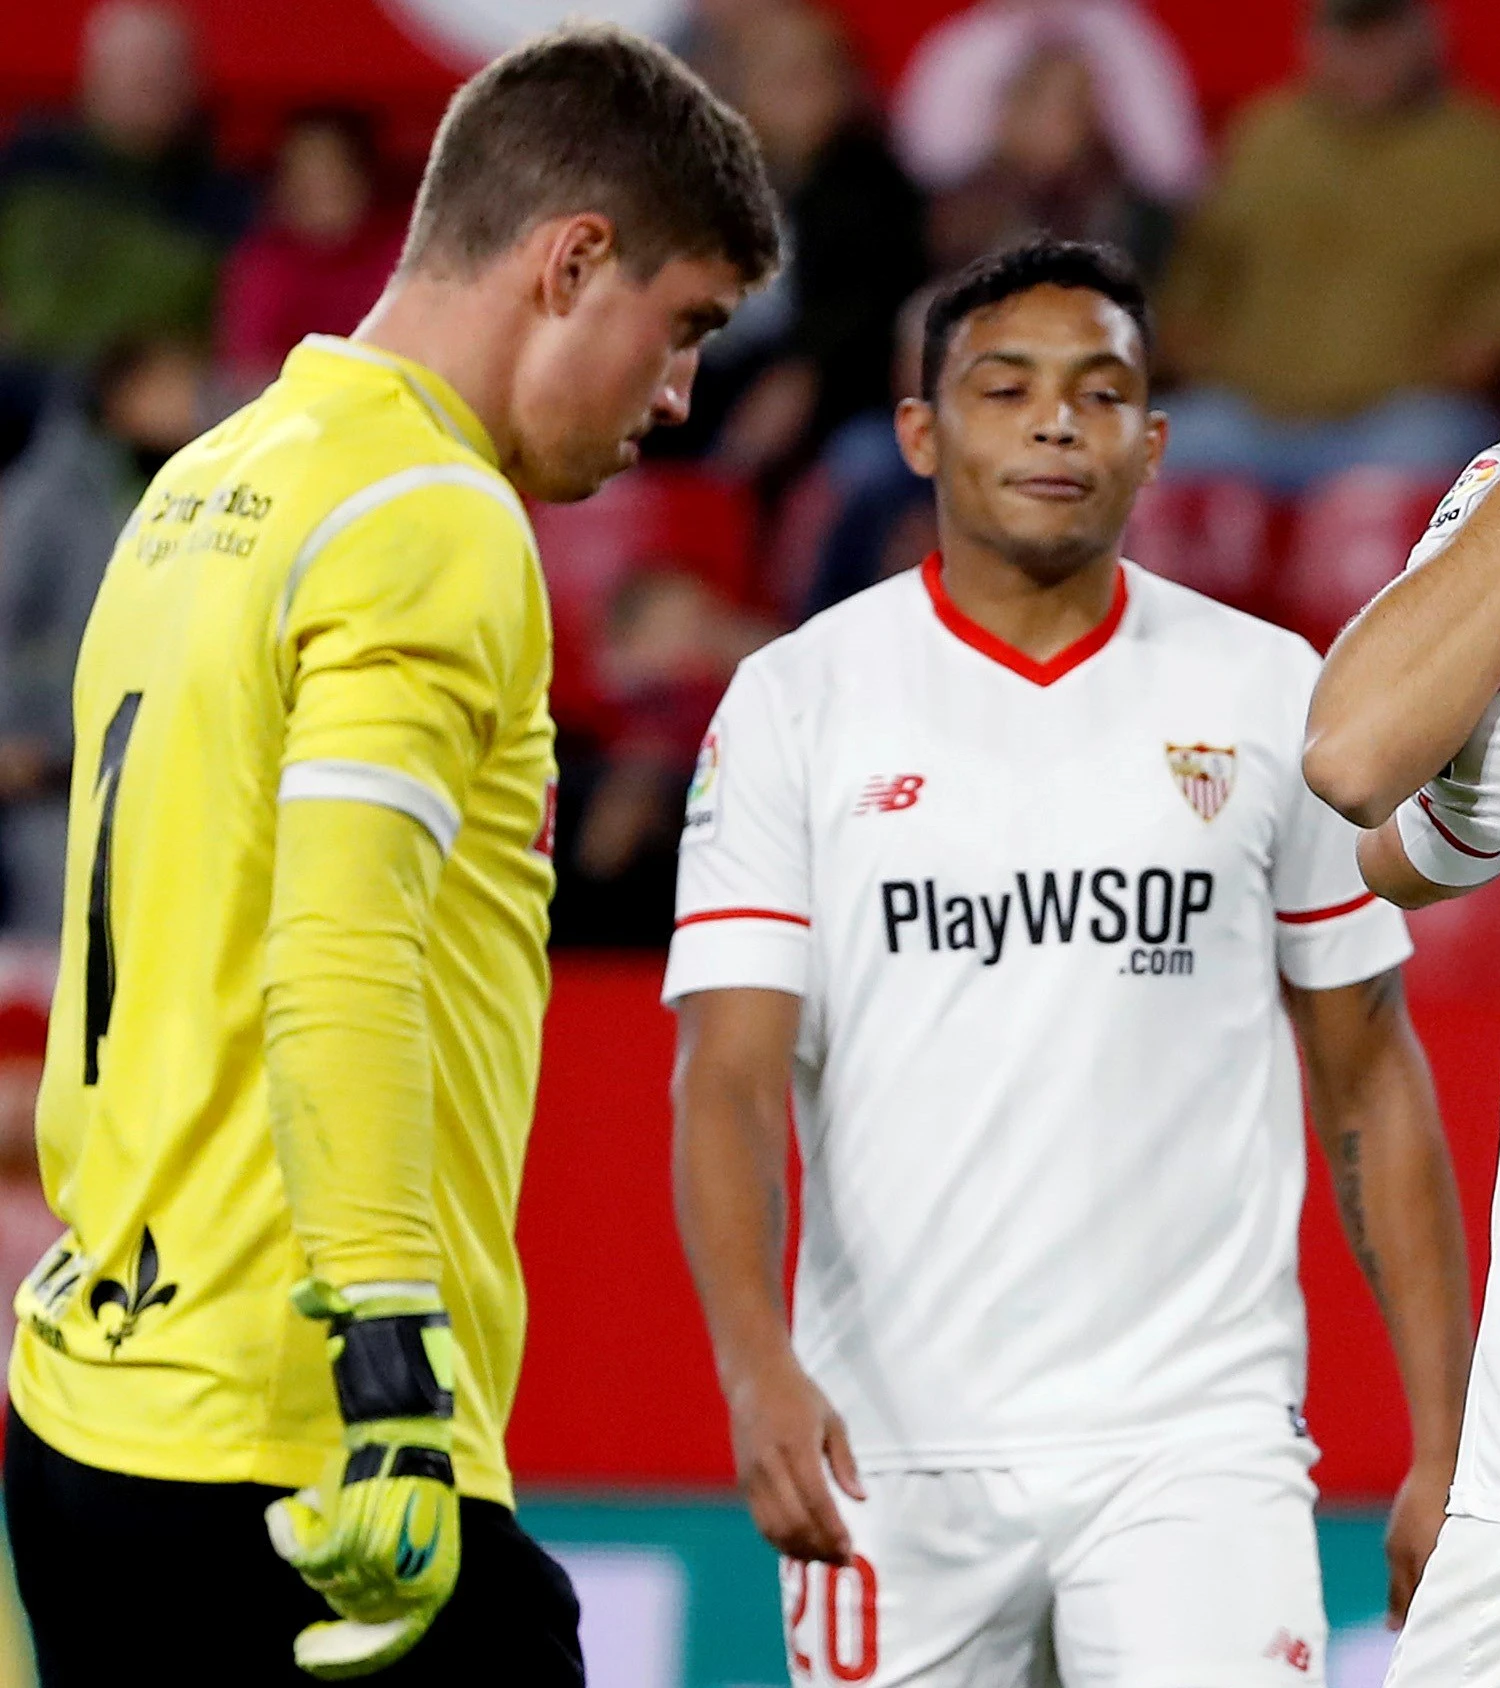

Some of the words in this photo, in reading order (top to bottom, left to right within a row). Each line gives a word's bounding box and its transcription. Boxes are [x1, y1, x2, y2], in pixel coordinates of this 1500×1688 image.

[83, 691, 144, 1086] 1
[881, 866, 1214, 966] PlayWSOP
[1118, 948, 1194, 976] .com
